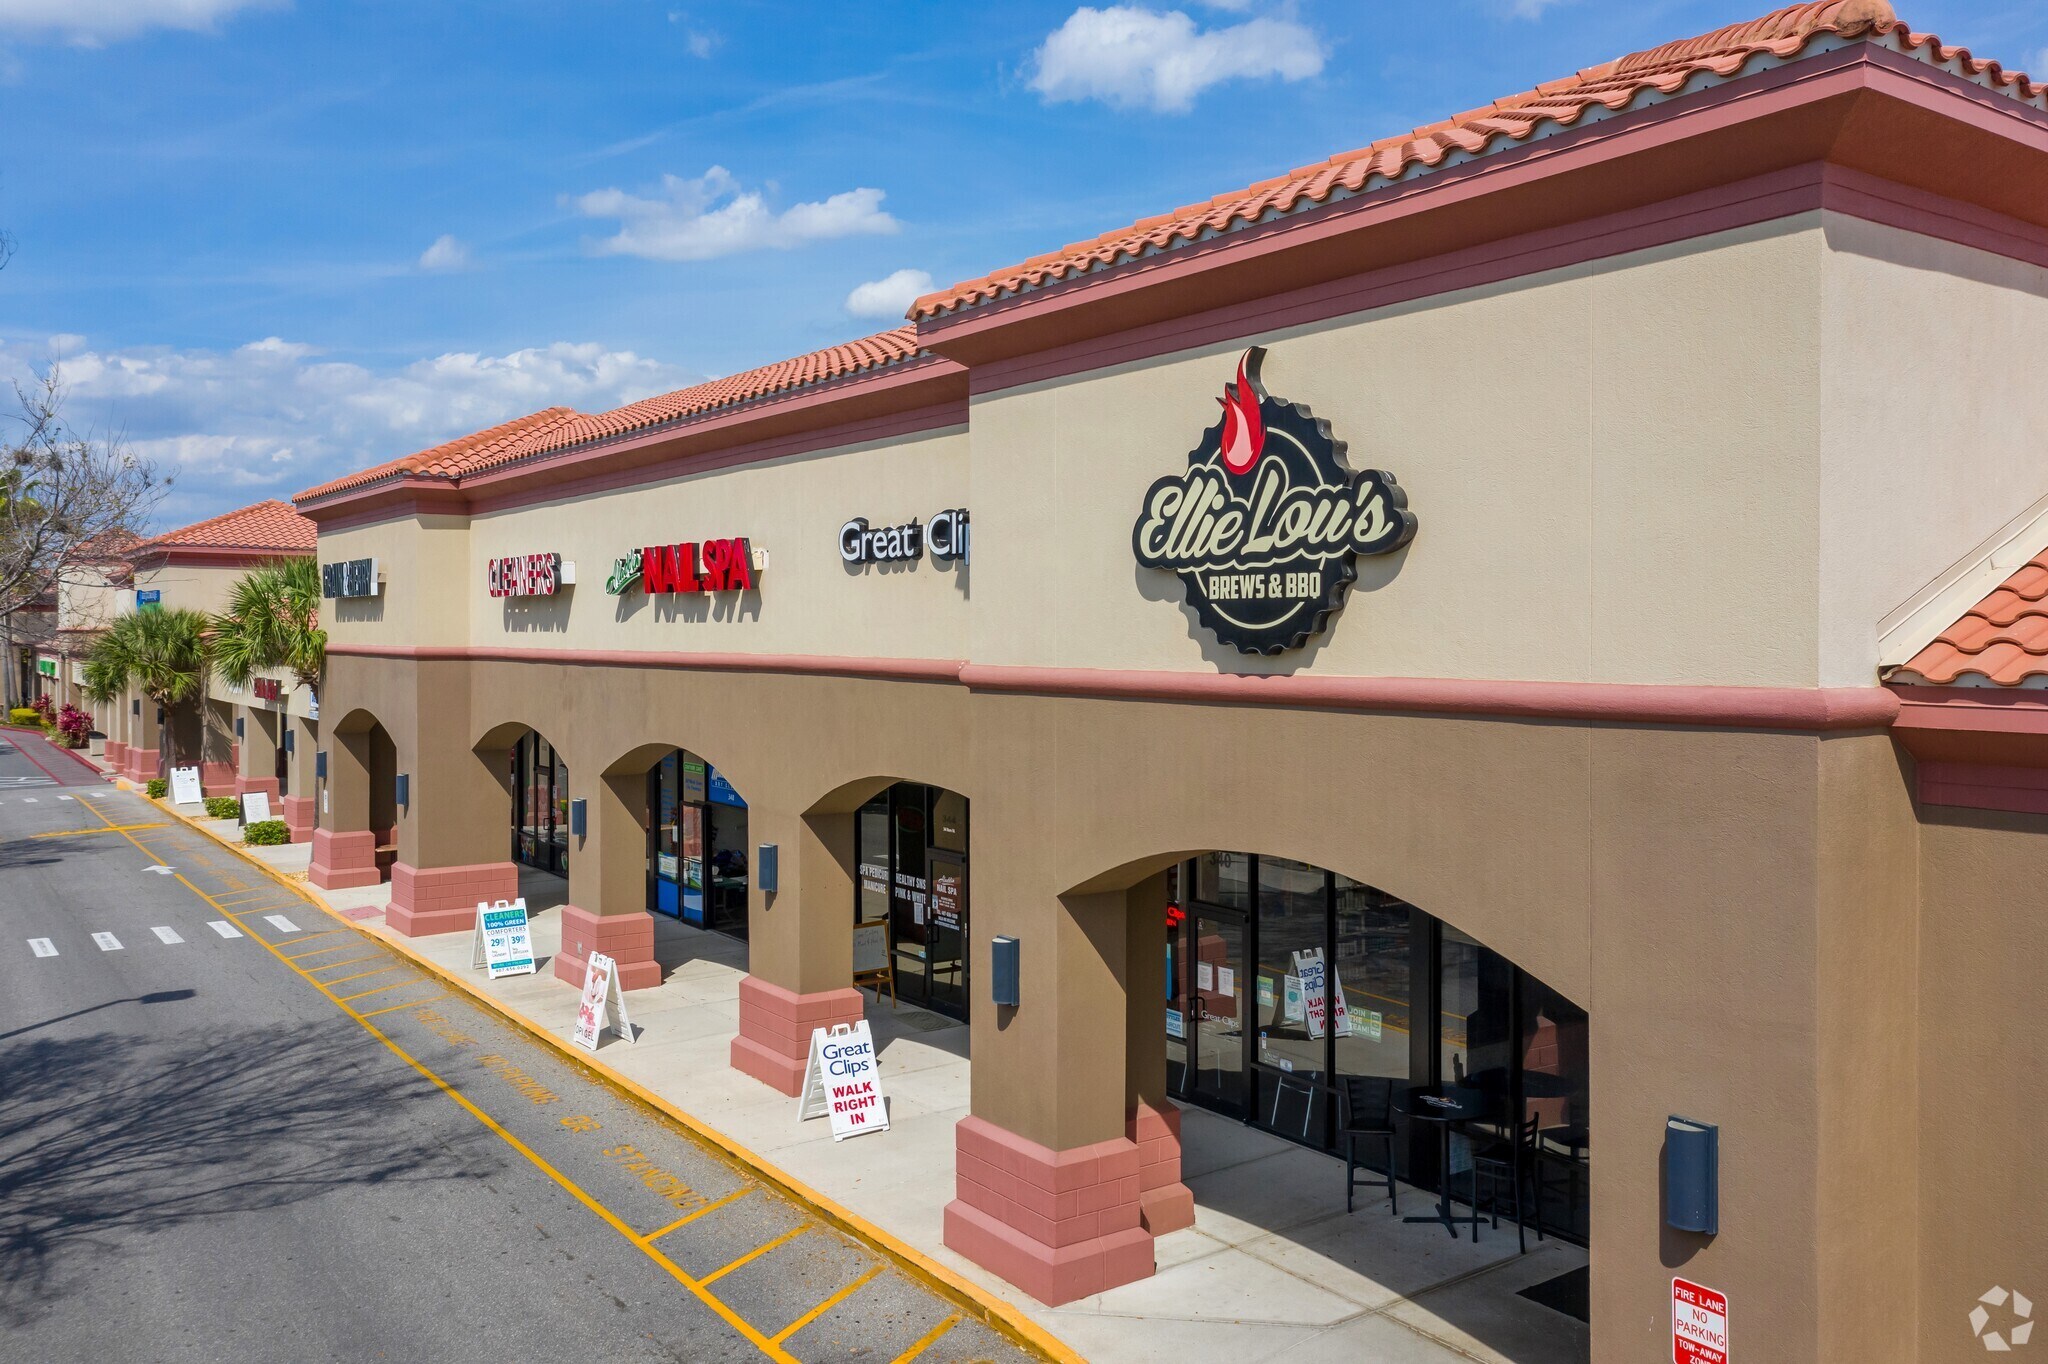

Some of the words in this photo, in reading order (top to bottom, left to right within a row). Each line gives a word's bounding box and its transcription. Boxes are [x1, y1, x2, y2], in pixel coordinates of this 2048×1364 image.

[1139, 475, 1244, 560] Ellie
[1241, 467, 1394, 556] Lou's
[838, 519, 915, 562] Great
[644, 542, 699, 594] NAIL
[702, 537, 752, 591] SPA
[488, 552, 556, 598] CLEANERS
[1208, 573, 1265, 600] BREWS
[1267, 574, 1284, 599] &
[1285, 571, 1321, 600] BBQ
[1210, 851, 1231, 868] 340
[860, 864, 869, 877] SPA
[896, 872, 915, 887] HEALTHY
[936, 883, 947, 894] NAIL
[947, 886, 958, 896] SPA
[484, 910, 524, 922] CLEANERS
[486, 926, 527, 936] COMFORTERS
[1200, 1009, 1221, 1023] Great
[1221, 1015, 1240, 1029] Clips
[1348, 1006, 1366, 1017] JOIN
[1348, 1014, 1363, 1025] THE
[583, 1028, 594, 1041] GEL
[1348, 1022, 1370, 1035] TEAM!
[822, 1042, 871, 1060] Great
[829, 1059, 870, 1077] Clips
[832, 1081, 874, 1099] WALK
[833, 1095, 877, 1113] RIGHT
[850, 1112, 865, 1125] IN
[1675, 1286, 1695, 1303] FIRE
[1699, 1294, 1725, 1314] LANE
[1692, 1308, 1708, 1324] NO
[1676, 1318, 1724, 1347] PARKING
[1678, 1338, 1723, 1364] TOW-AWAY
